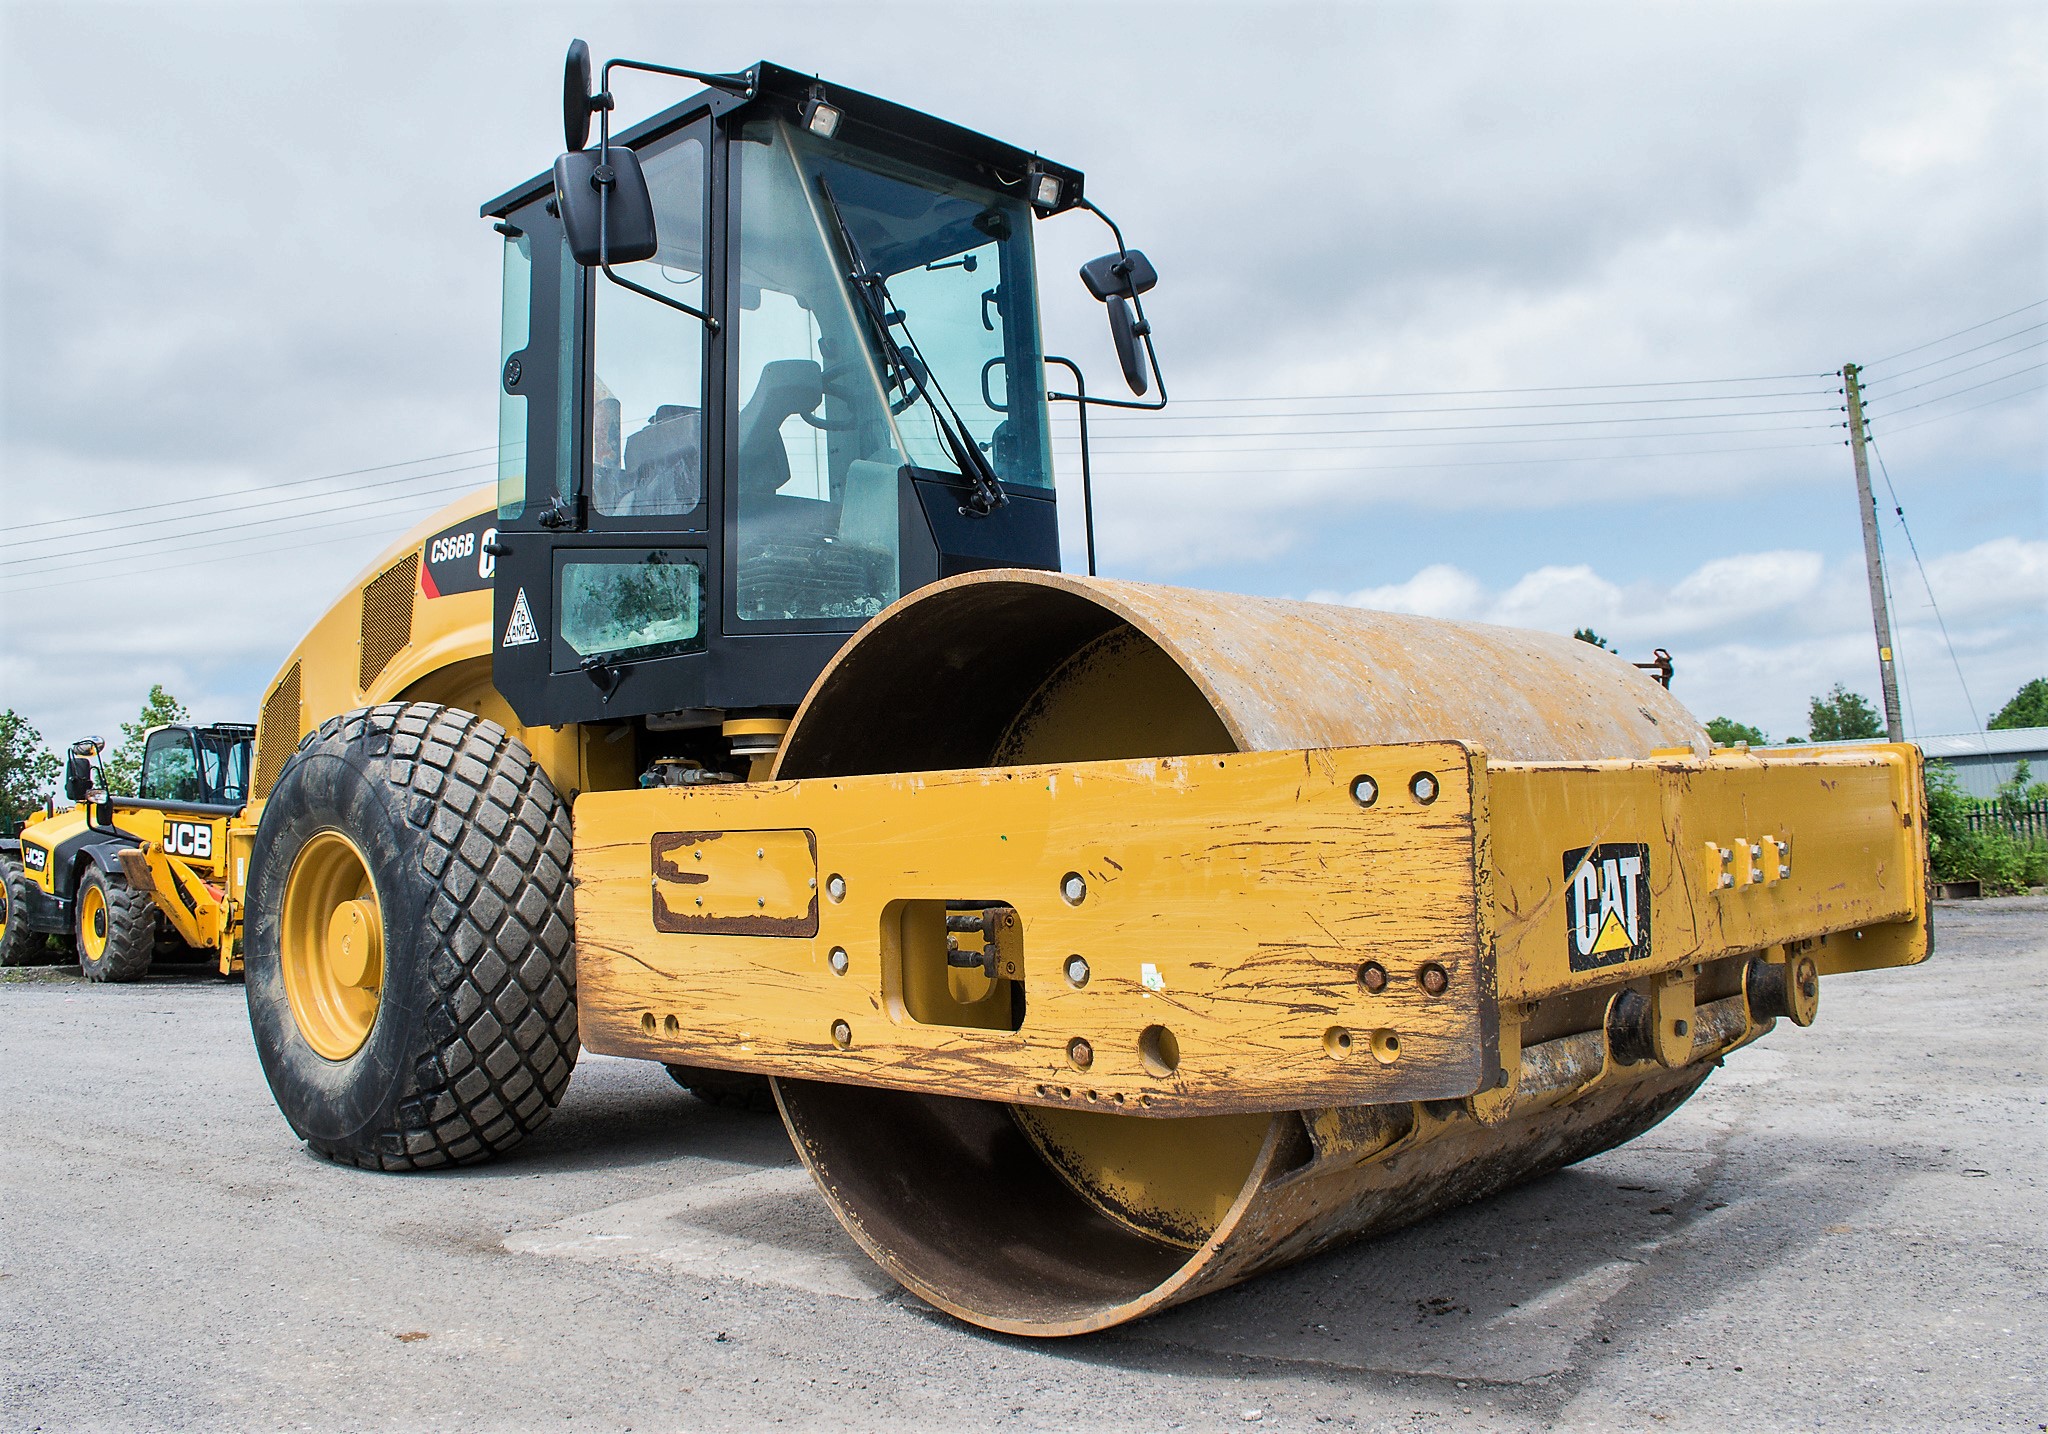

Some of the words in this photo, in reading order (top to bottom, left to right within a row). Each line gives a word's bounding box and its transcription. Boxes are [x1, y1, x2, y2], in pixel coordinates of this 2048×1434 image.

[430, 532, 475, 564] CS66B
[25, 846, 46, 867] JCB
[163, 822, 212, 858] JCB
[1574, 856, 1641, 955] CAT
